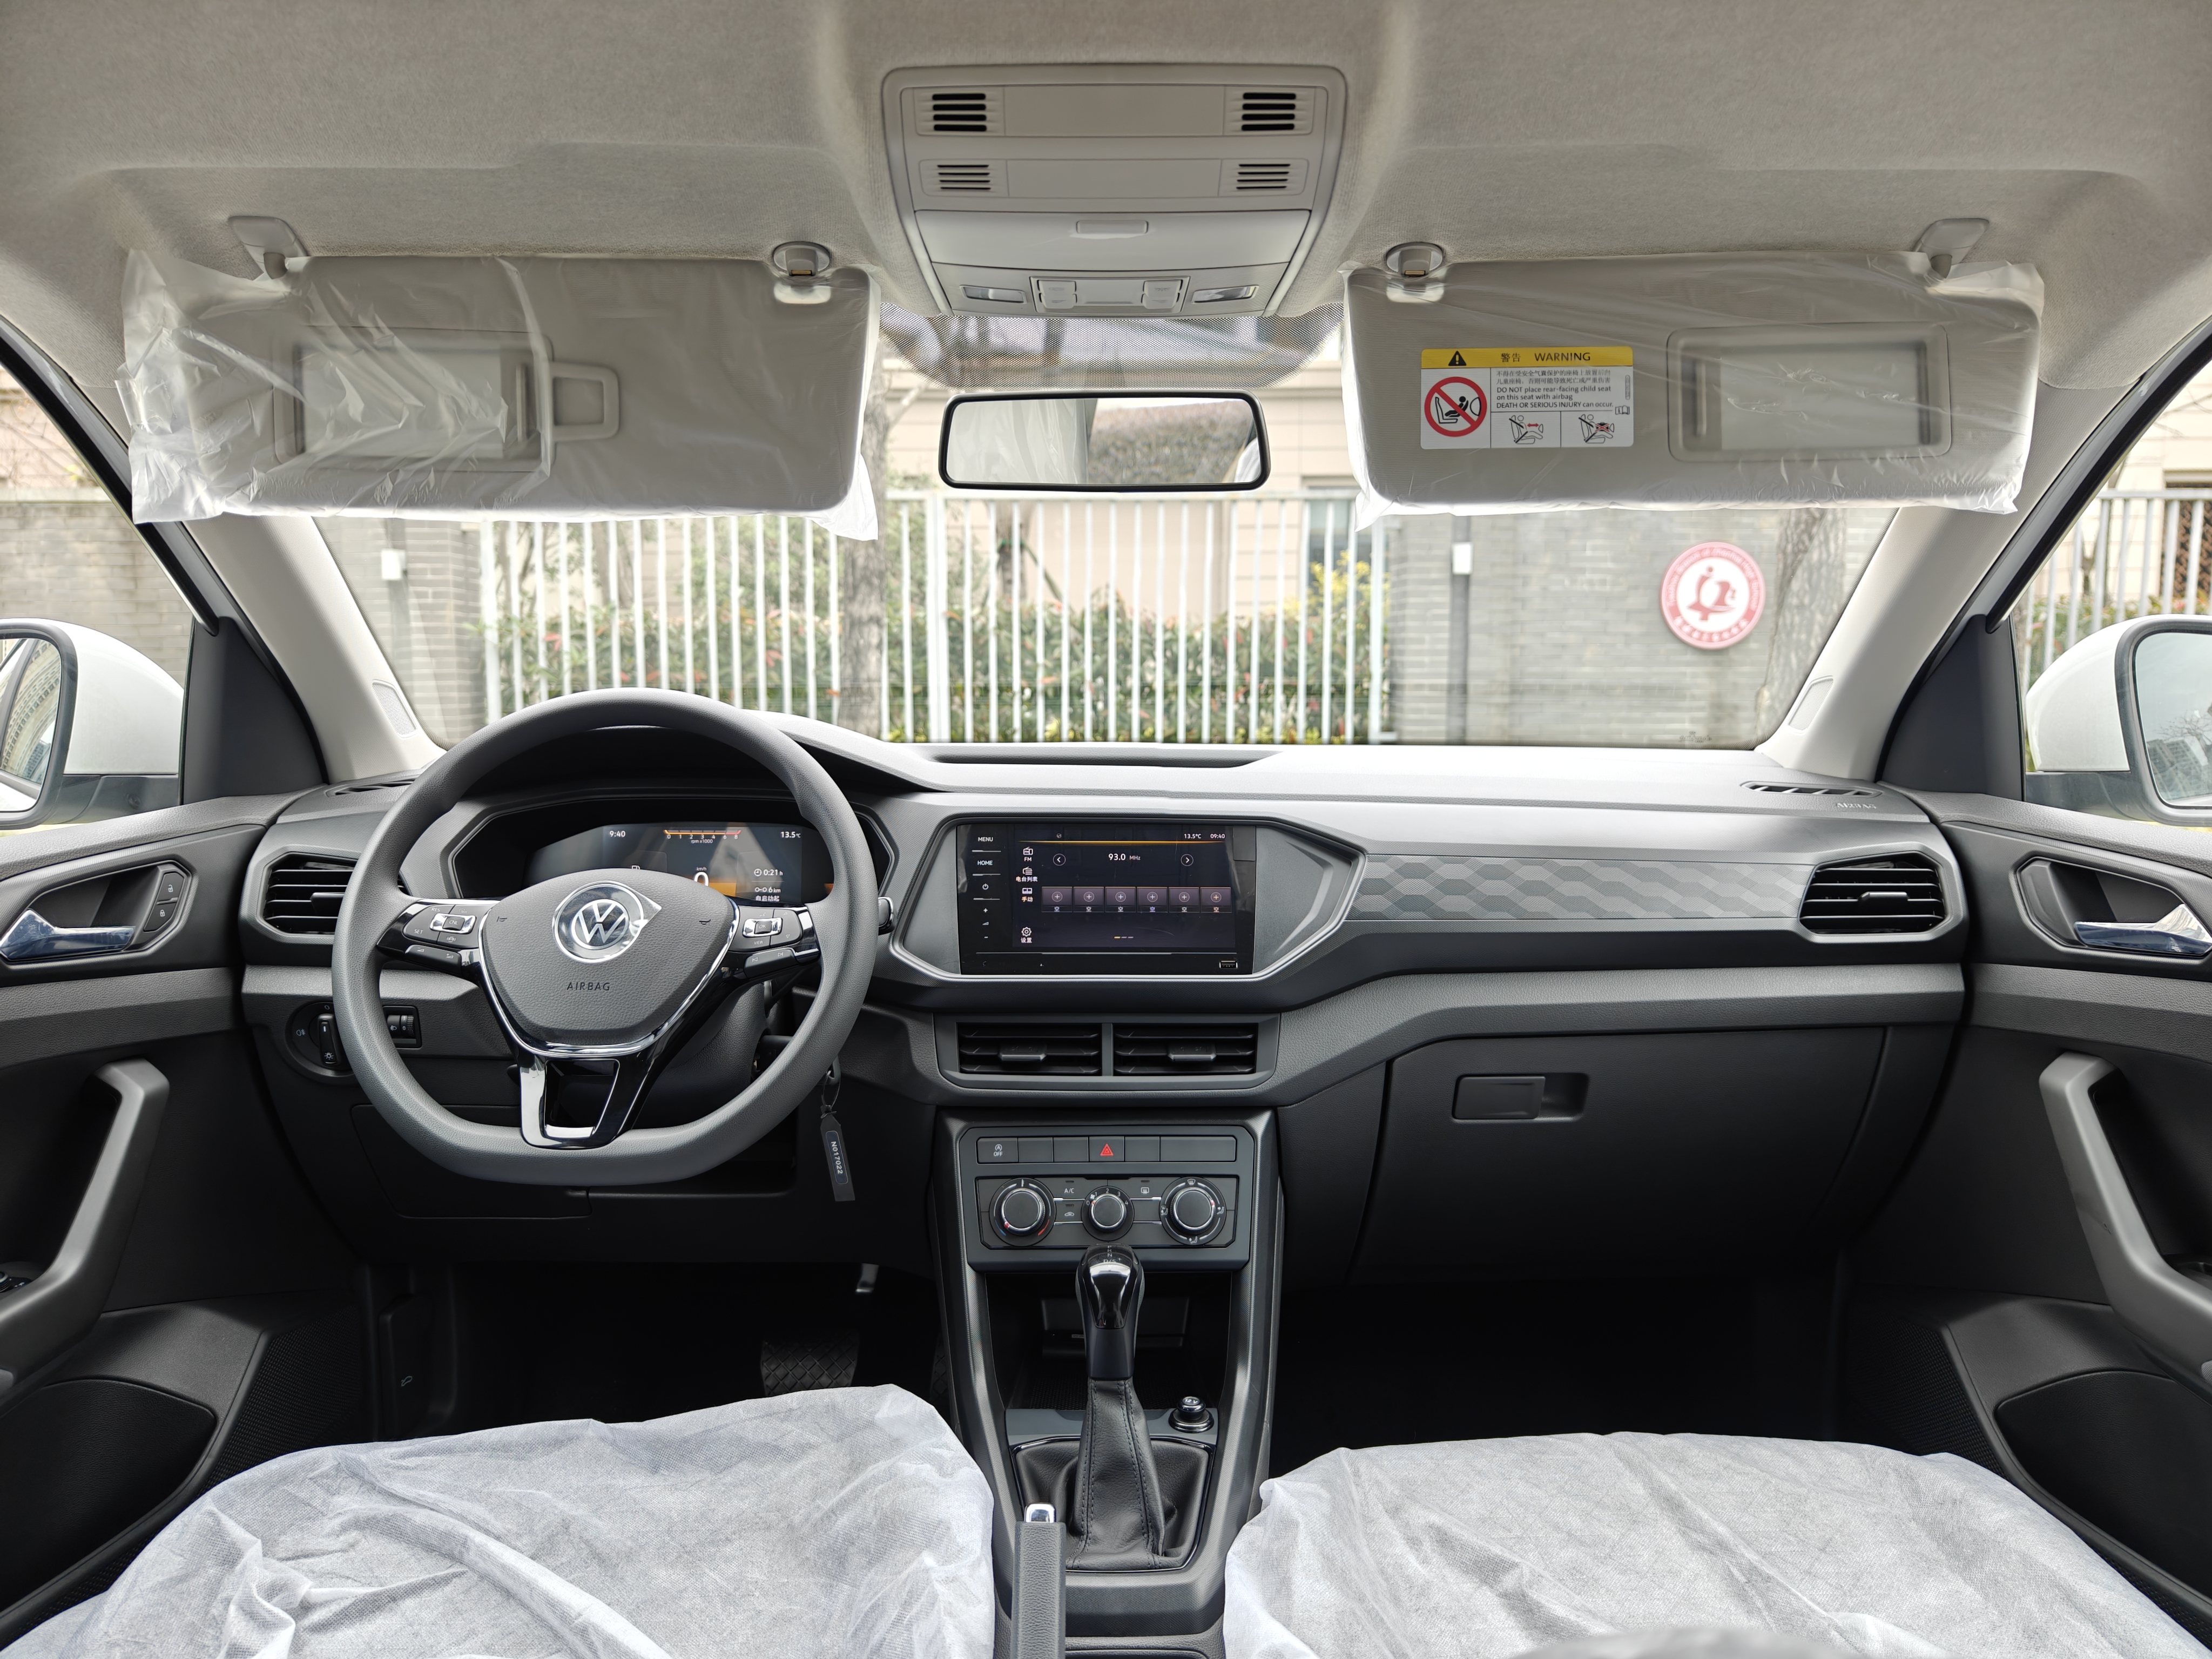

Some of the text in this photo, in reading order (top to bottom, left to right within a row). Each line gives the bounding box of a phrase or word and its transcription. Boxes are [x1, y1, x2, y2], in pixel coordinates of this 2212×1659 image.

[1501, 353, 1521, 362] 警告
[1535, 352, 1590, 361] WARNING
[1543, 386, 1579, 394] rear-facing
[567, 982, 610, 991] AIRBAG
